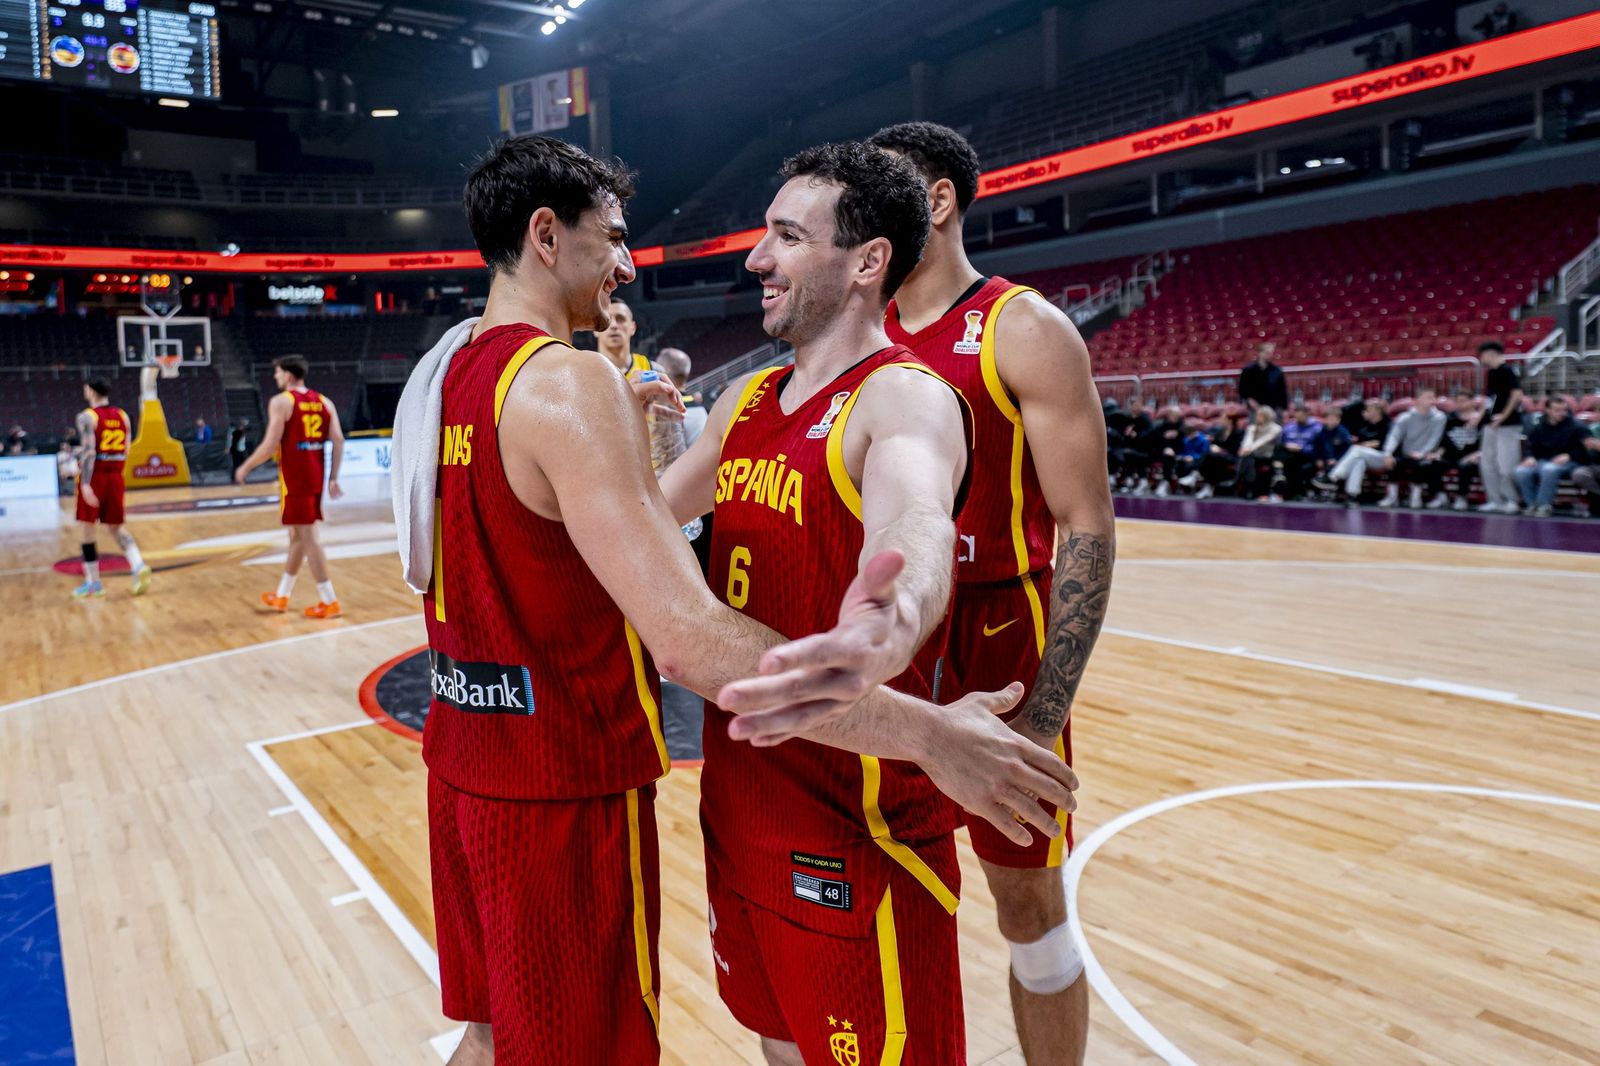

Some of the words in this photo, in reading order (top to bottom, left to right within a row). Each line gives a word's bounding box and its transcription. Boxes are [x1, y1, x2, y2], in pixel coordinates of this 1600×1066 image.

[1332, 54, 1476, 104] superalko.lv
[1132, 116, 1234, 153] superalko.lv
[100, 429, 125, 451] 22
[302, 413, 323, 438] 12
[442, 424, 474, 466] NAS
[714, 453, 803, 526] SPAÑA
[726, 545, 752, 610] 6
[794, 854, 810, 863] TODOS
[824, 887, 839, 900] 48
